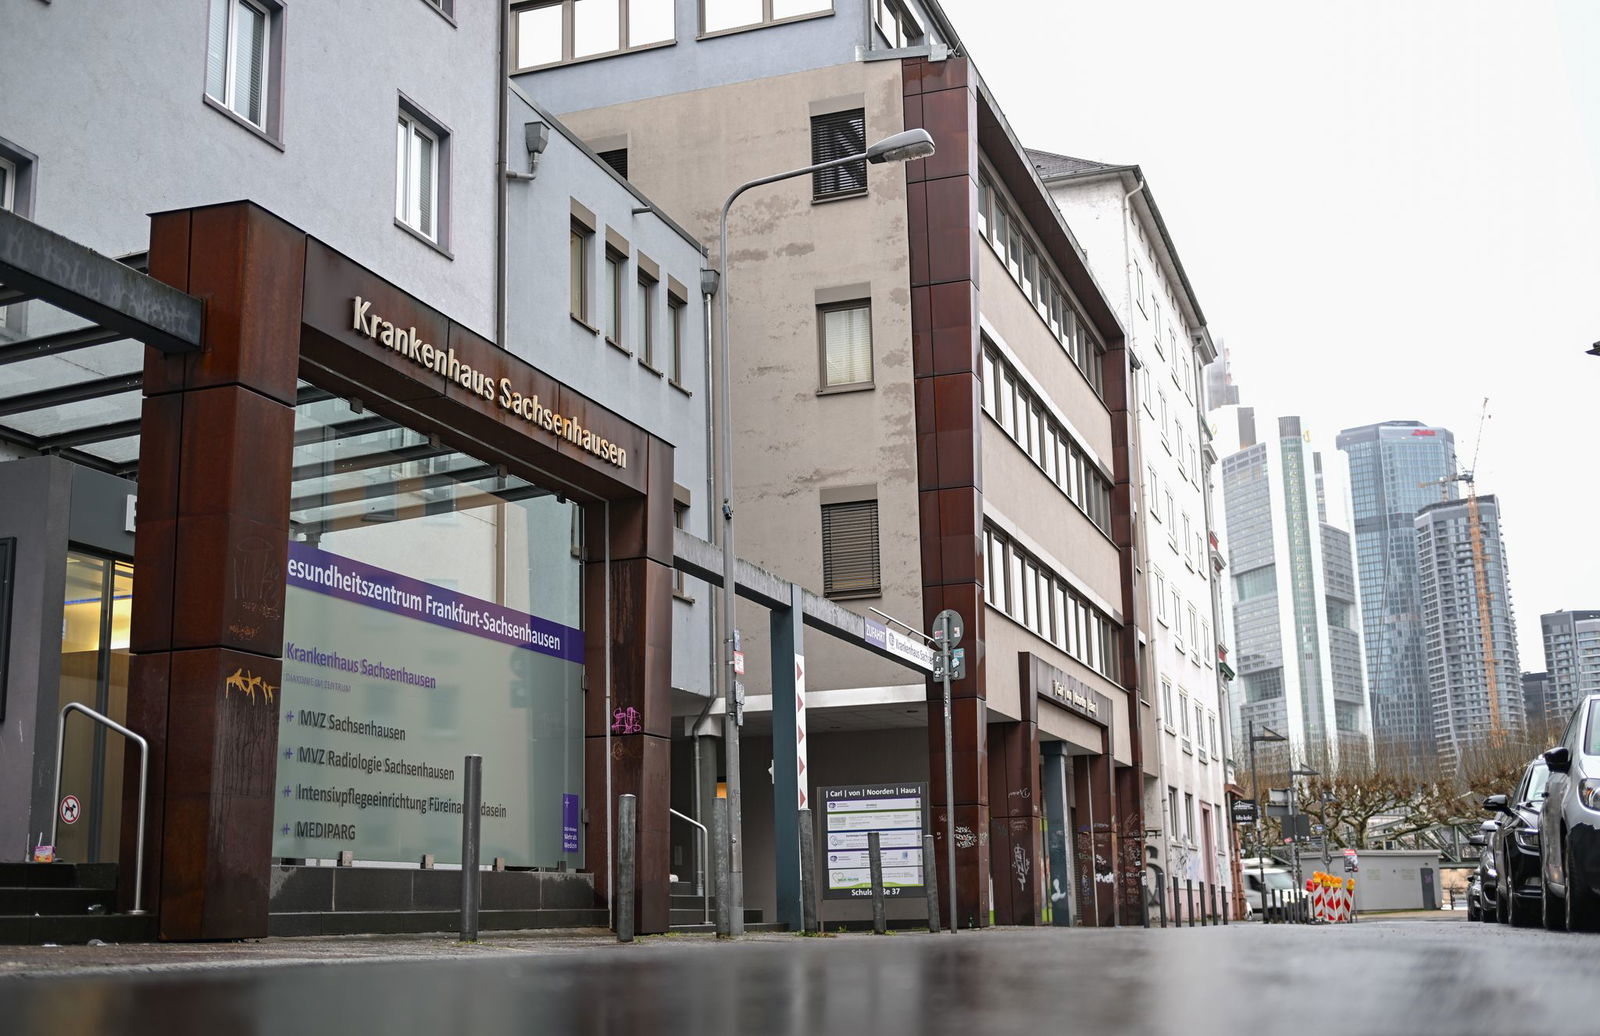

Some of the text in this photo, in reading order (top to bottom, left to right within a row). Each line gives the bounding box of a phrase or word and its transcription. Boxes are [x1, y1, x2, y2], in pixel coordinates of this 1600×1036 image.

[352, 295, 627, 469] Krankenhaus Sachsenhausen
[287, 557, 561, 651] esundheitszentrum Frankfurt-Sachsenhausen
[286, 642, 436, 689] Krankenhaus Sachsenhausen
[299, 709, 406, 741] MVZ Sachsenhausen
[298, 746, 455, 781] MVZ Radiologie Sachsenhausen
[296, 783, 427, 815] Intensivpflegeeinrichtung
[829, 790, 843, 798] Carl
[866, 788, 894, 796] Noorden
[900, 787, 916, 795] Haus
[296, 820, 356, 841] MEDIPARG
